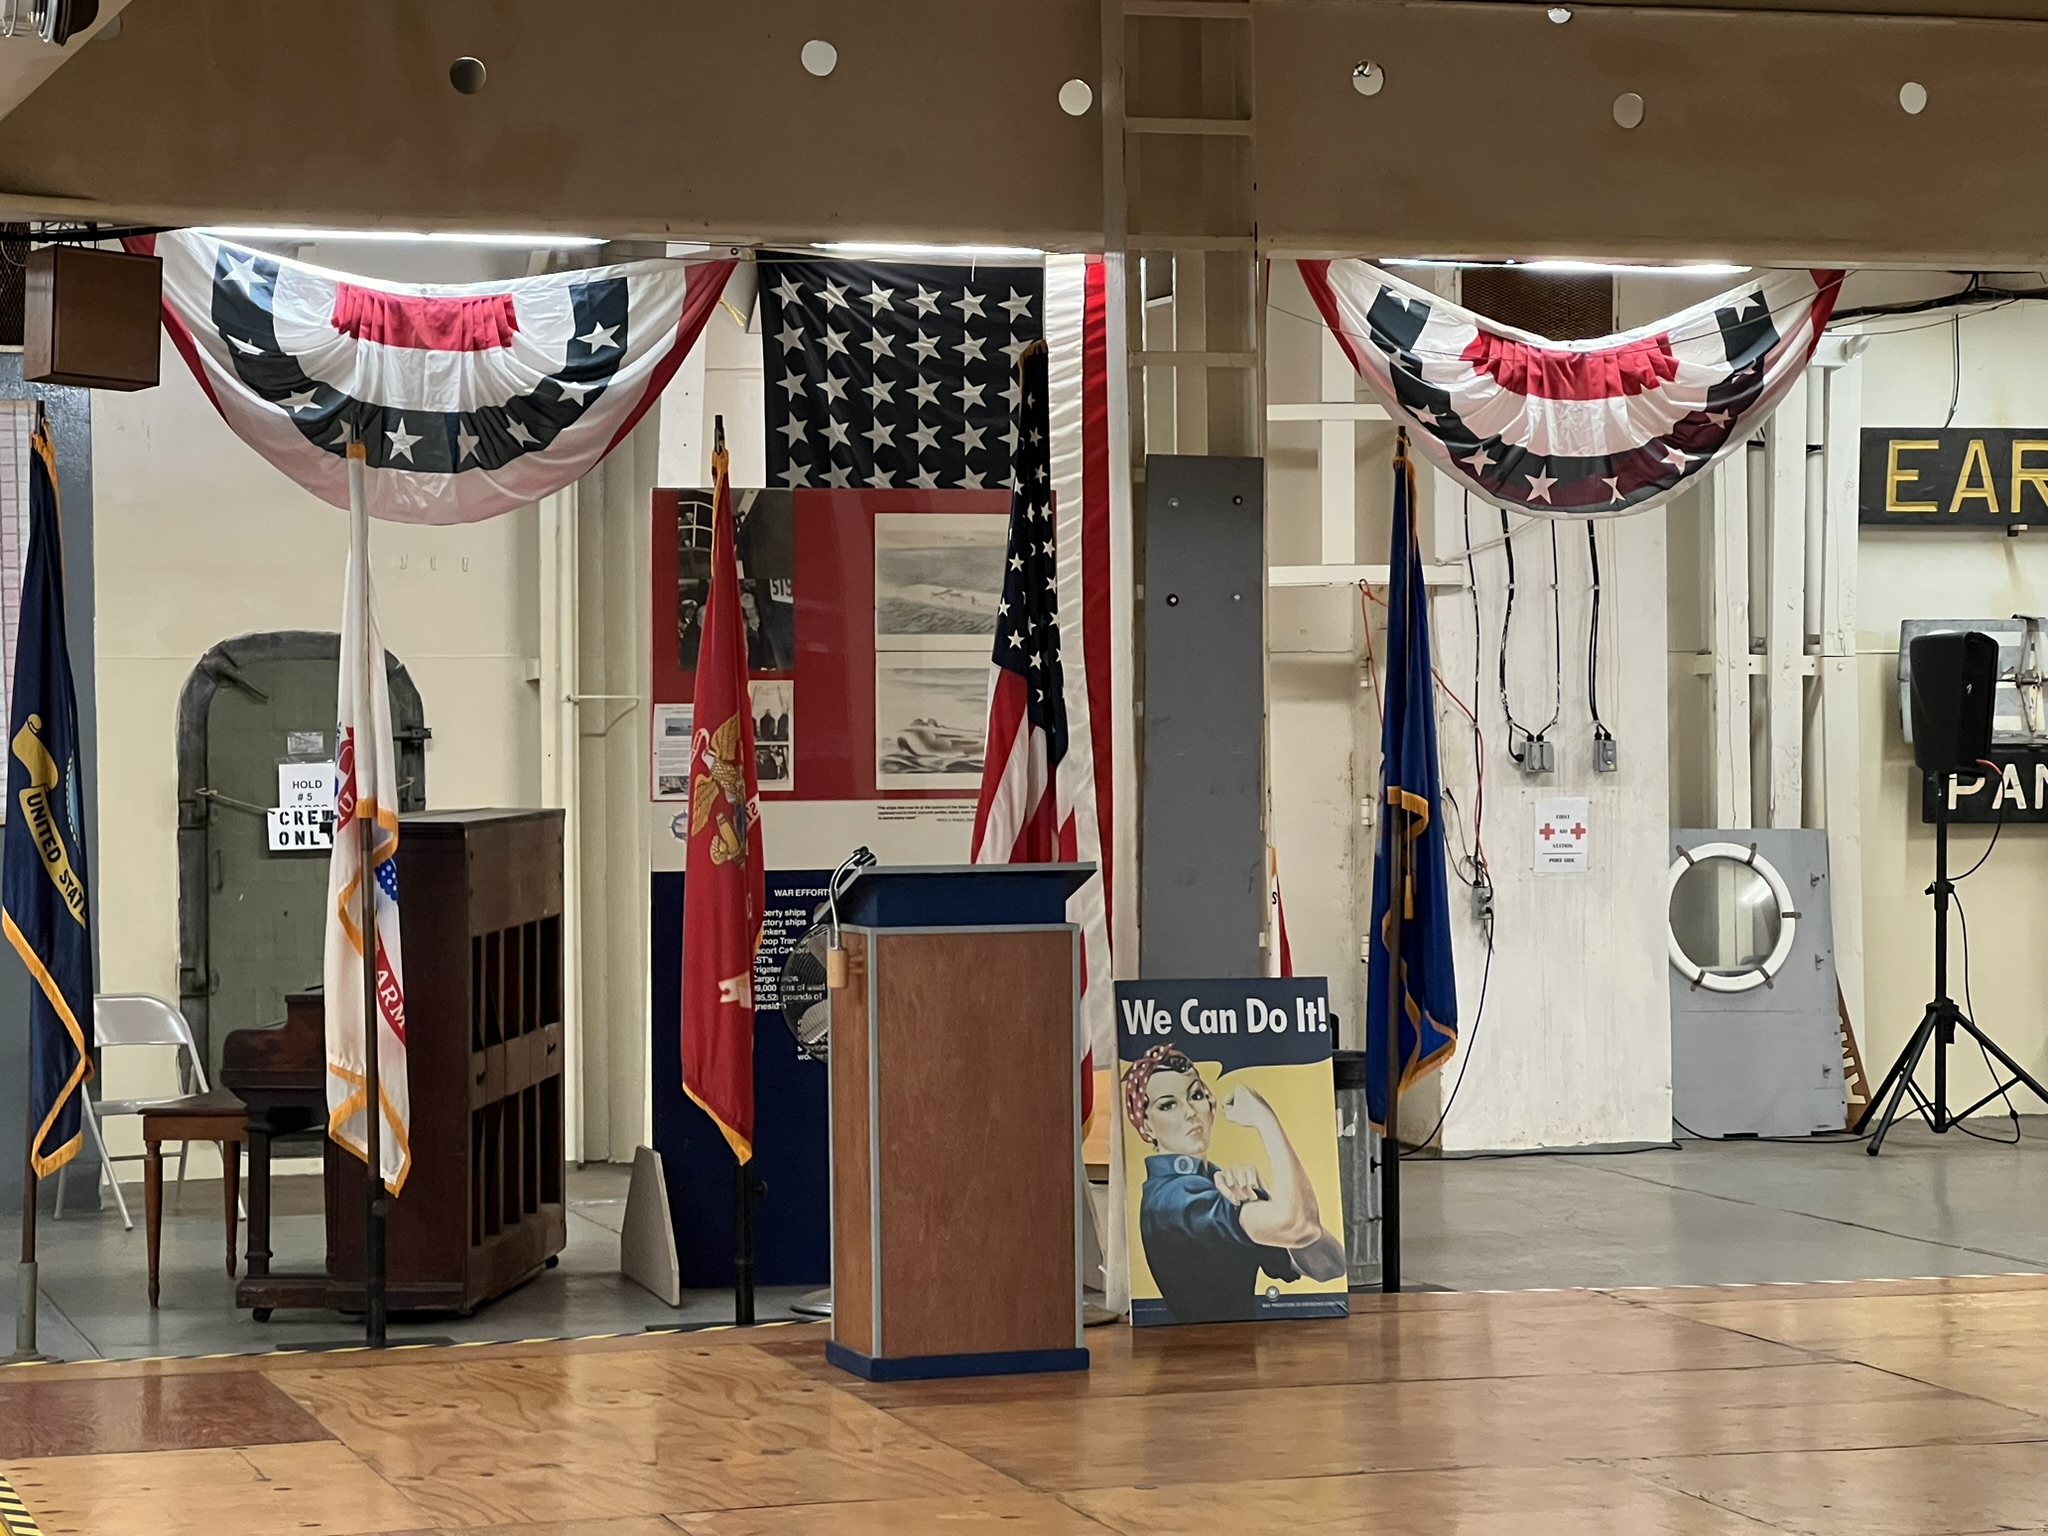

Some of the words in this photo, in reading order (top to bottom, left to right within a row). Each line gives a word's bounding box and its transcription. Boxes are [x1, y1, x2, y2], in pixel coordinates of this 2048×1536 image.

[1886, 439, 2048, 514] EAR
[292, 780, 323, 789] HOLD
[297, 793, 304, 801] #
[306, 792, 313, 801] 5
[26, 792, 62, 863] UNITED
[774, 889, 794, 897] WAR
[784, 908, 806, 918] ships
[763, 919, 783, 928] ctory
[784, 918, 807, 927] ships
[754, 956, 773, 964] ST's
[1121, 998, 1173, 1035] We
[1180, 998, 1238, 1034] Can
[1246, 998, 1288, 1034] Do
[1296, 997, 1328, 1033] It!
